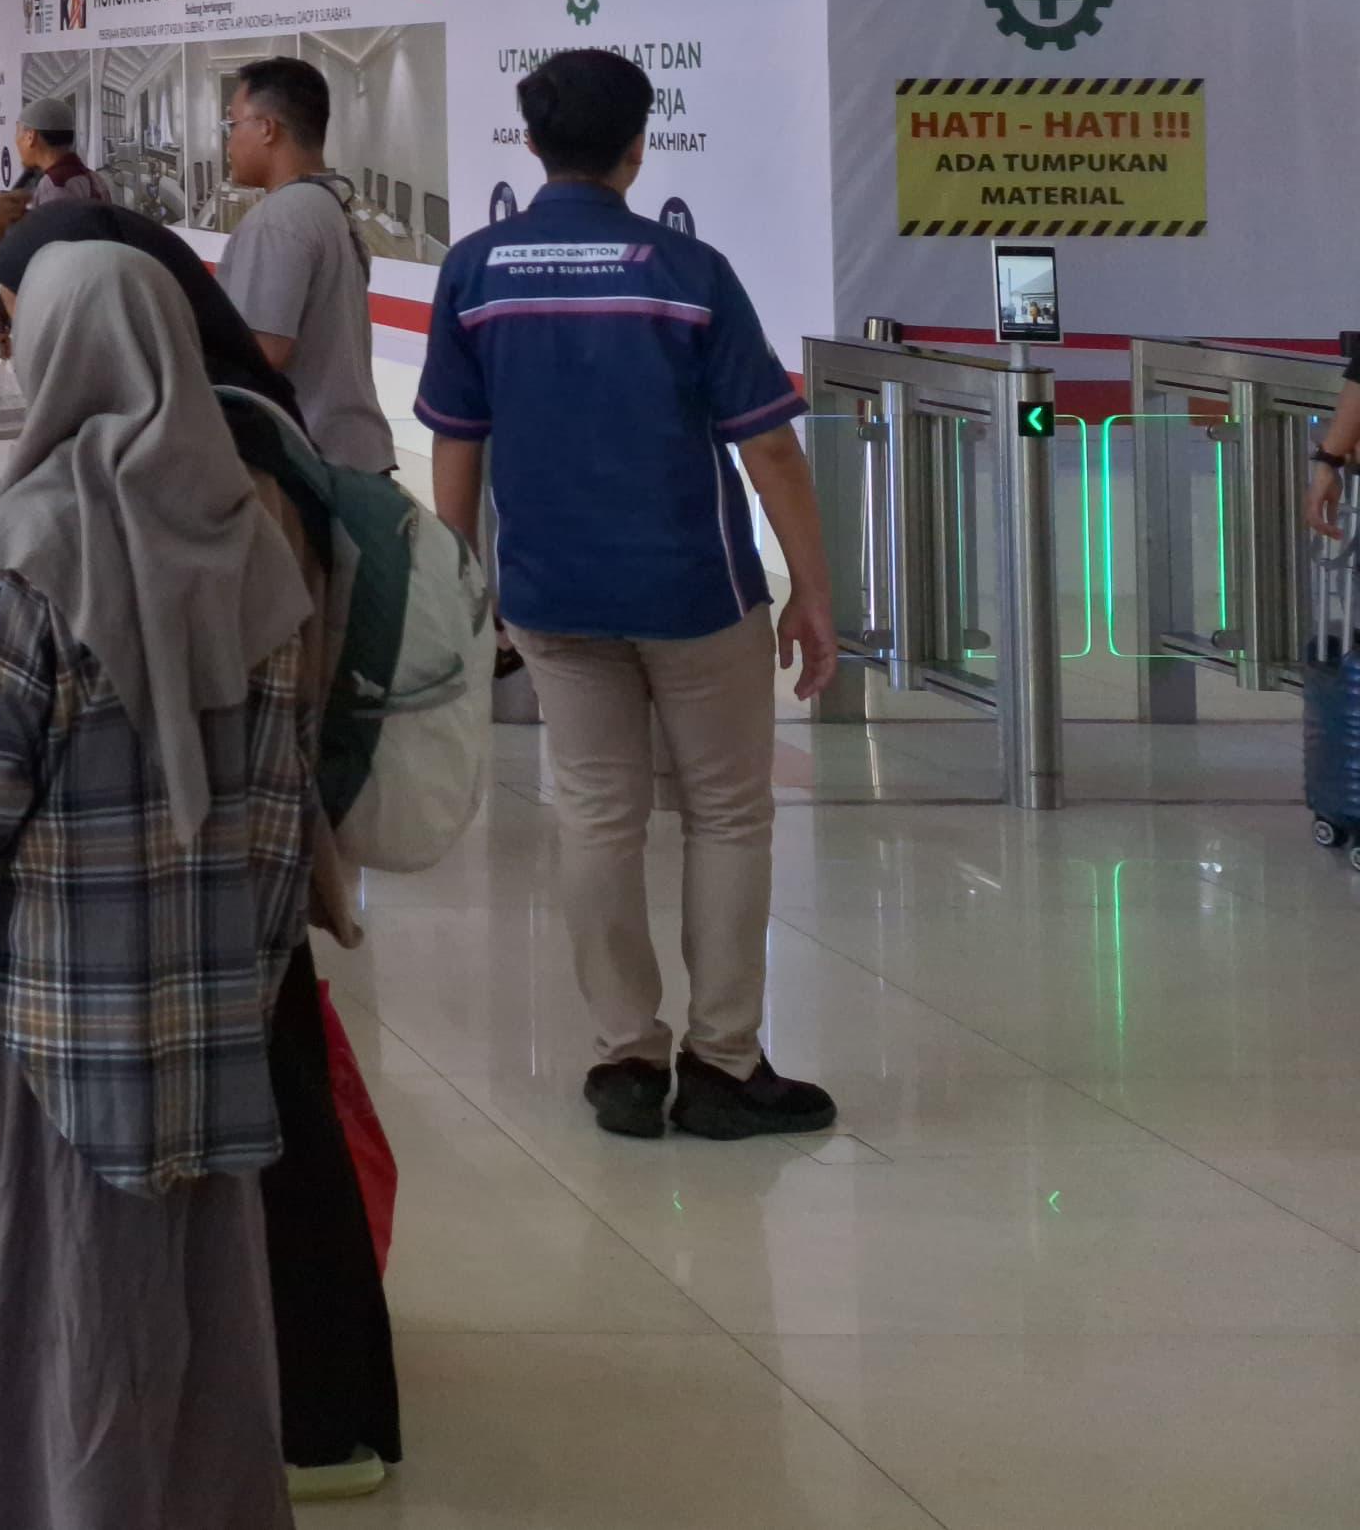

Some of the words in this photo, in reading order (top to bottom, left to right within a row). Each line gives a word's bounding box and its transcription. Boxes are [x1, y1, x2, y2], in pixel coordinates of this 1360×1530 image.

[661, 41, 702, 70] DAN
[911, 111, 1007, 138] HATI
[1044, 111, 1141, 138] HATI
[1153, 111, 1191, 138] !!!
[493, 128, 521, 145] AGAR
[649, 132, 707, 152] AKHIRAT
[935, 153, 995, 173] ADA
[1004, 153, 1168, 173] TUMPUKAN
[981, 186, 1125, 205] MATERIAL
[496, 250, 528, 259] FACE
[531, 247, 619, 258] RECOGNITION
[508, 266, 544, 275] DAOP
[558, 265, 625, 274] SURABAYA
